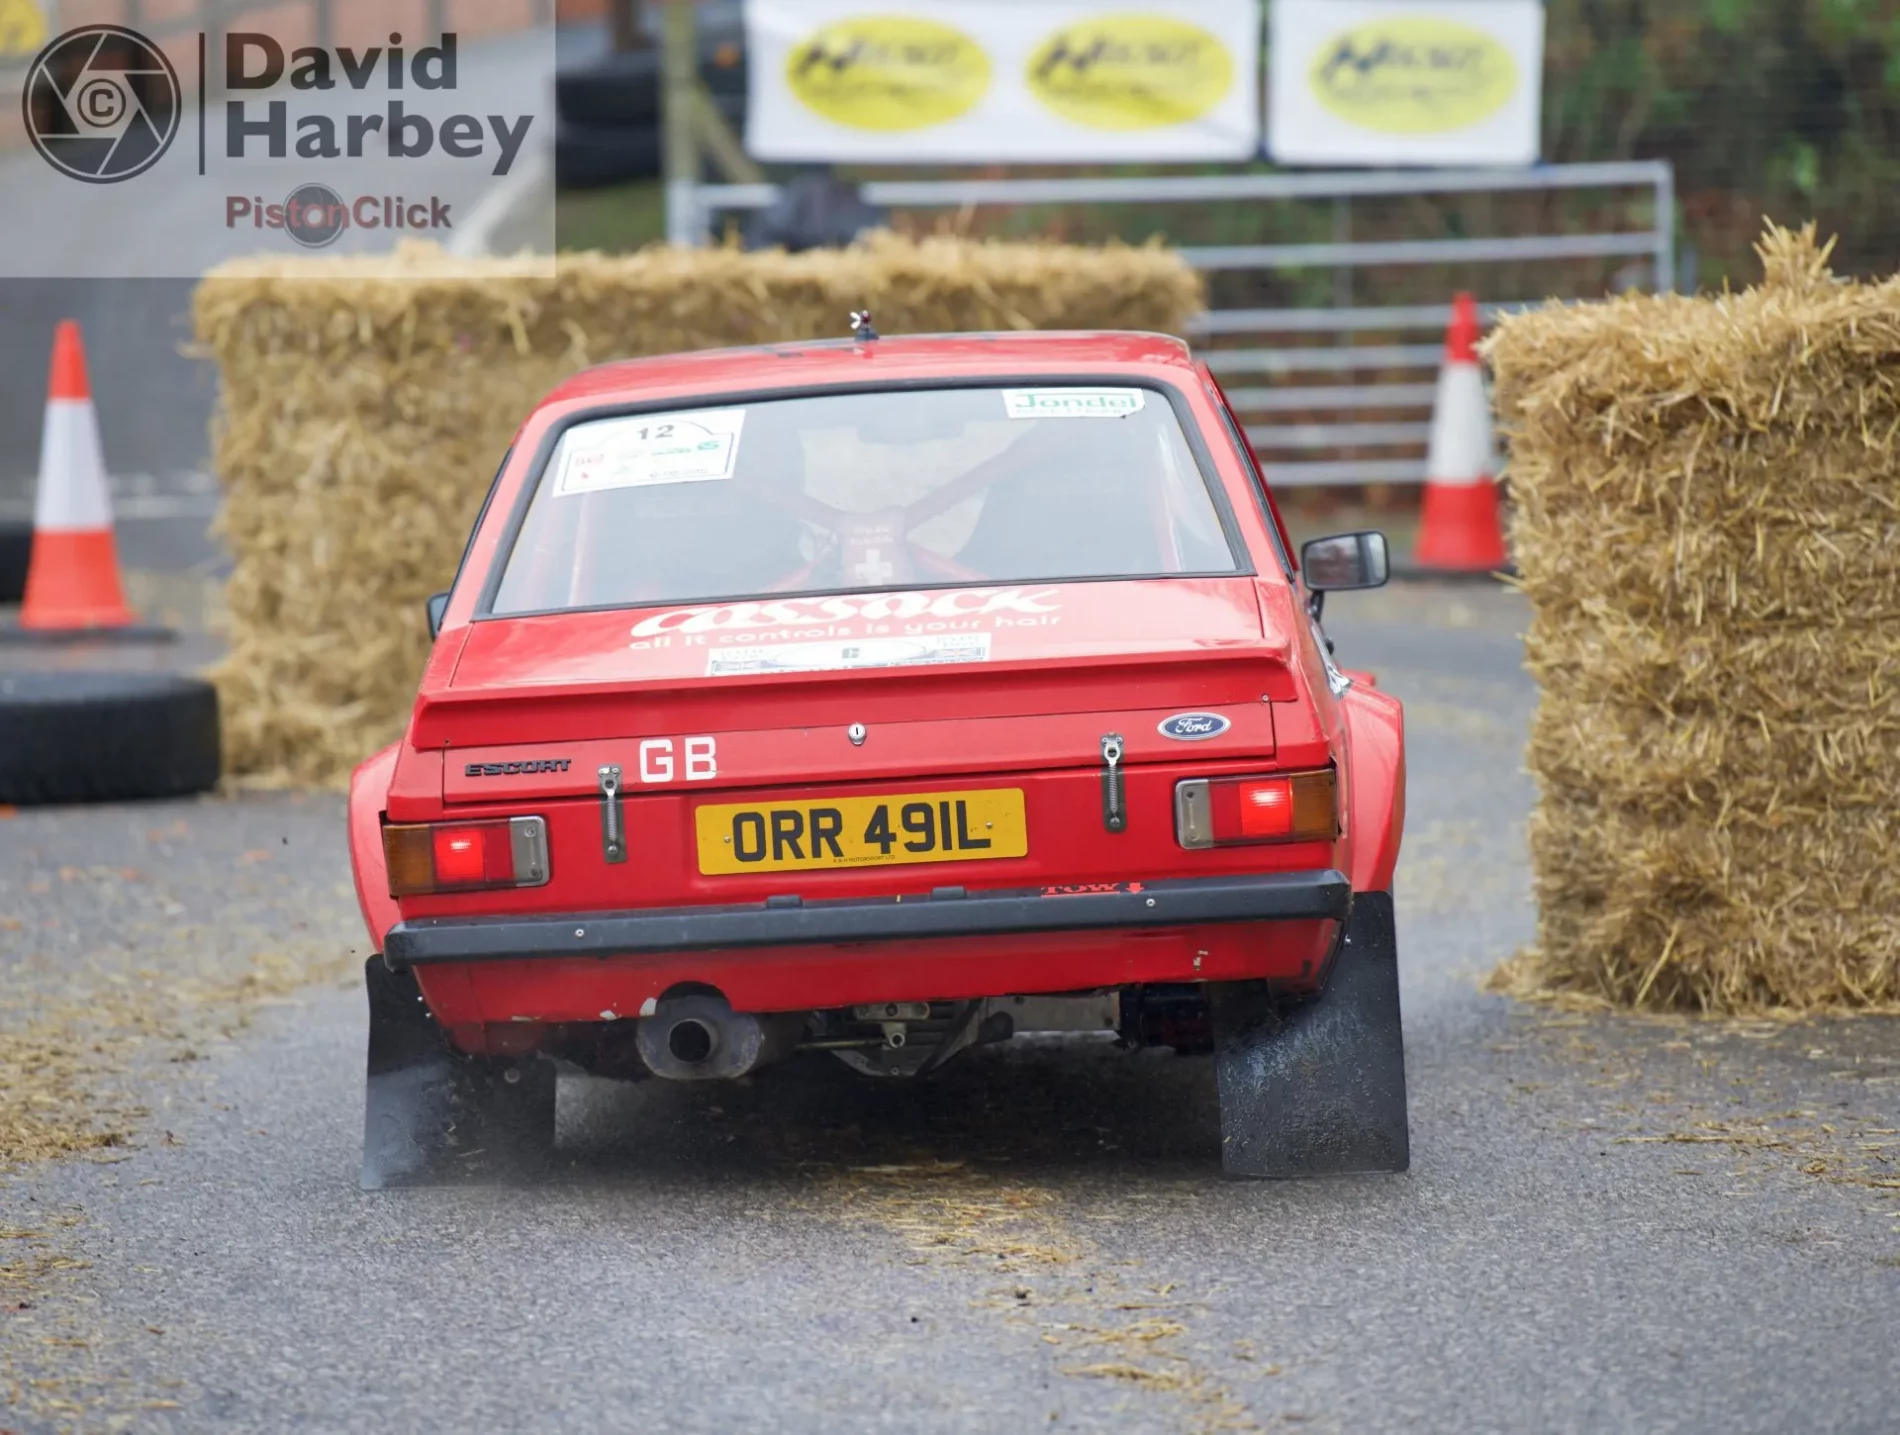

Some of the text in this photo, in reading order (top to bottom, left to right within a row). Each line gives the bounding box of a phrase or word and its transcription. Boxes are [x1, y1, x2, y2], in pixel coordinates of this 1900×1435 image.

[637, 423, 676, 441] 12
[629, 614, 1061, 650] all it controls is your hair
[1174, 716, 1213, 734] Ford
[464, 758, 572, 777] ESCORT
[732, 799, 992, 863] ORR 491L
[1041, 882, 1120, 895] TOW
